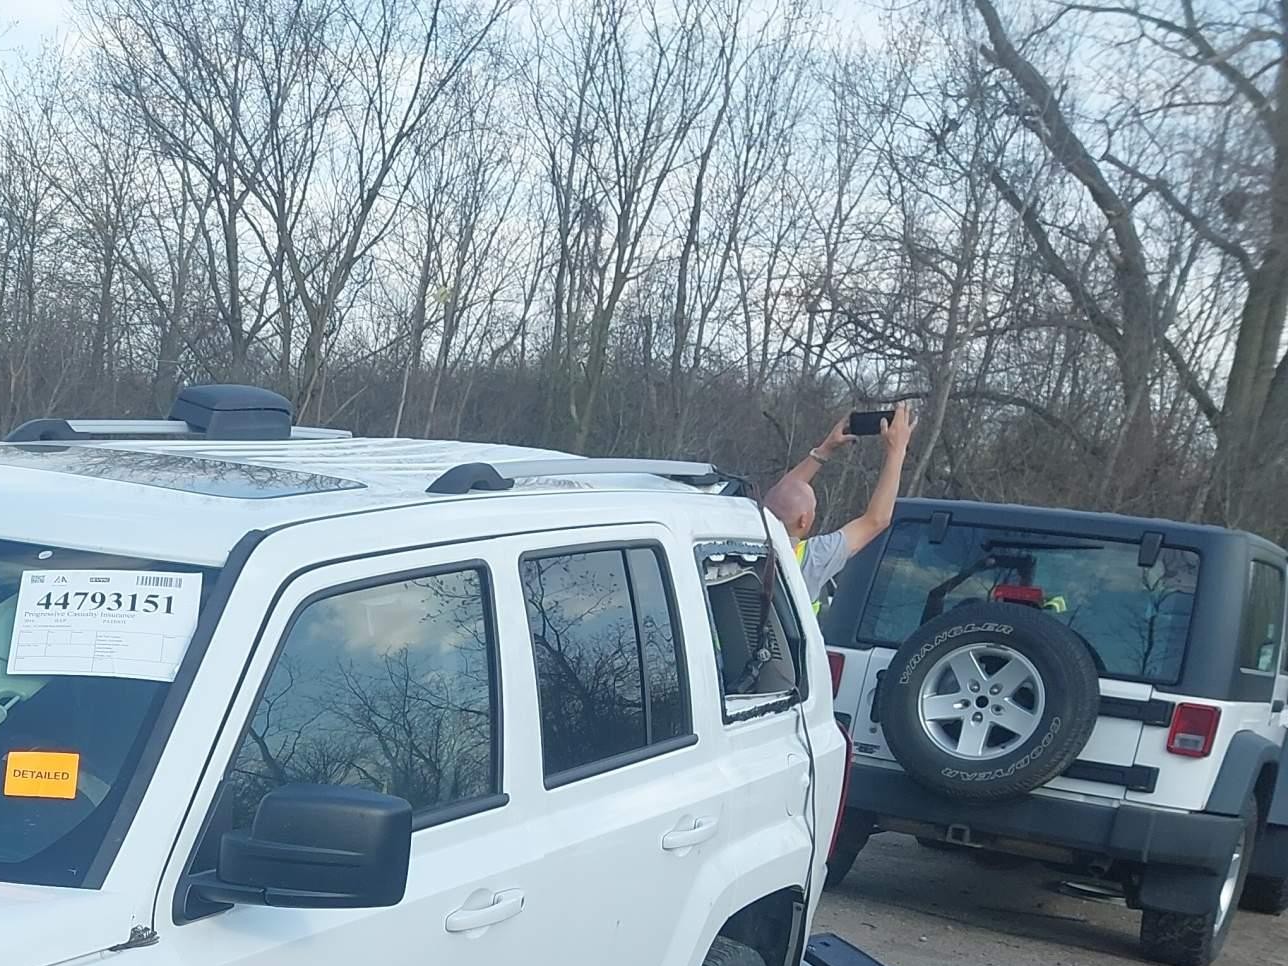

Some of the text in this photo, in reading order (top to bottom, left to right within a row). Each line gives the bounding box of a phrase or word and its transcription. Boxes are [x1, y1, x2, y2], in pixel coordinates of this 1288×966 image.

[37, 591, 175, 615] 44793151
[24, 610, 136, 619] Progressive Casualty Insurance
[899, 622, 1014, 685] WRANGLER
[13, 768, 70, 781] DETAILED
